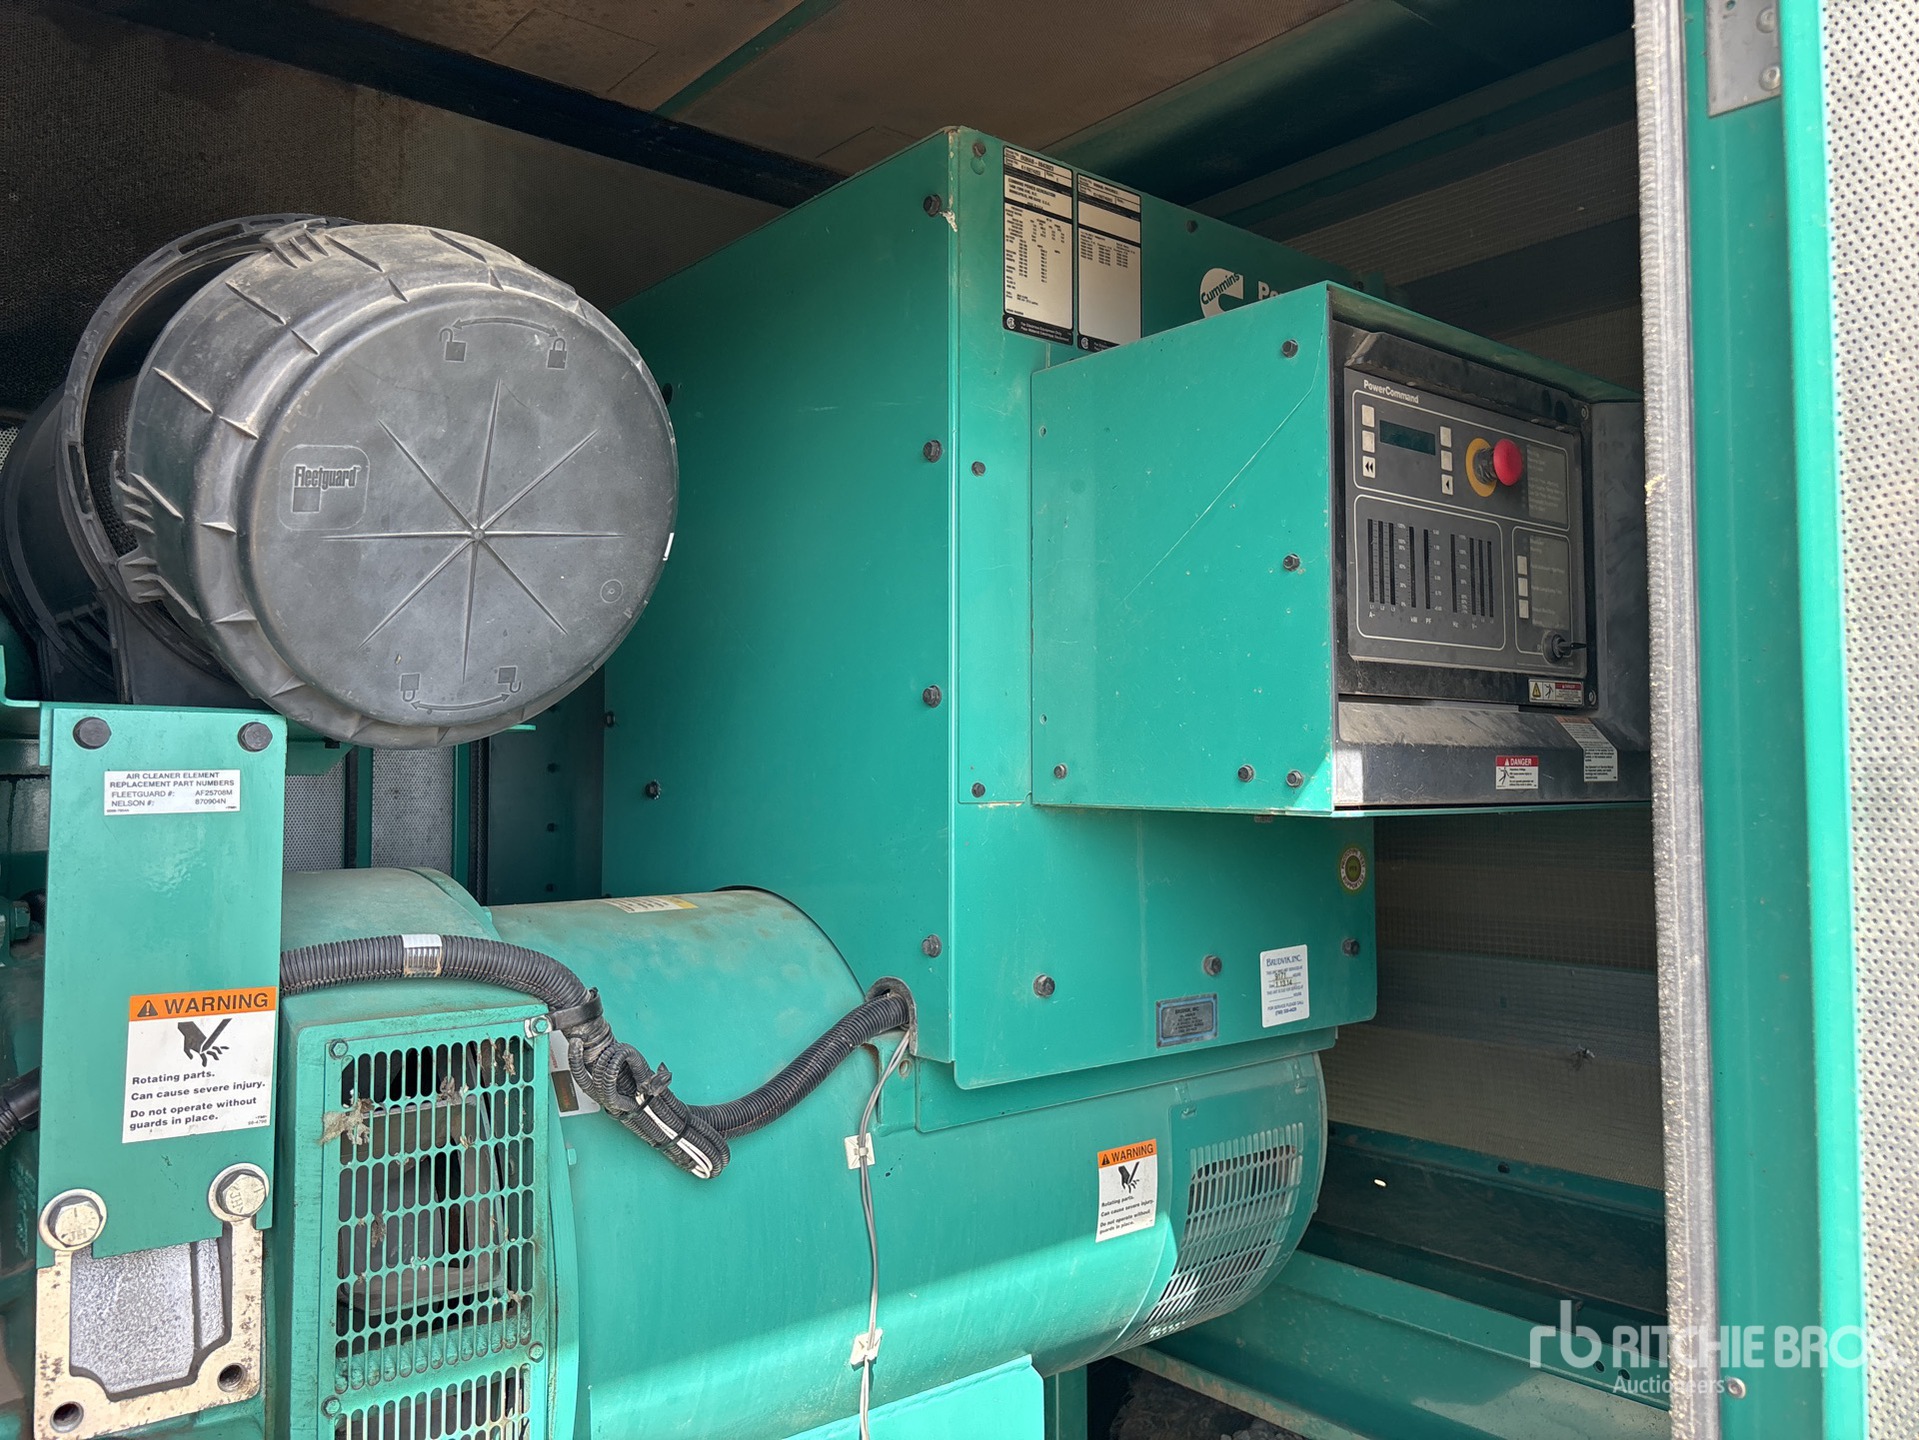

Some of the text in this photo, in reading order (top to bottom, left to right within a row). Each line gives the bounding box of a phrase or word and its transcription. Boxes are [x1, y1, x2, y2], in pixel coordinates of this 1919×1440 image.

[1201, 273, 1240, 305] Cummins
[1363, 379, 1419, 404] PowerCommand
[294, 464, 361, 491] Fleetguard
[1510, 757, 1532, 767] DANGER
[126, 772, 140, 780] AIR
[196, 779, 235, 787] NUMBERS
[111, 799, 145, 807] NELSON
[165, 993, 268, 1015] WARNING
[132, 1070, 215, 1085] Rotating parts.
[131, 1080, 266, 1101] Can cause severe injury.
[130, 1097, 257, 1118] Do not operate without
[129, 1113, 218, 1132] guards in place.
[1111, 1144, 1154, 1162] WARNING
[1101, 1198, 1121, 1208] Rotating
[1116, 1214, 1133, 1223] operate
